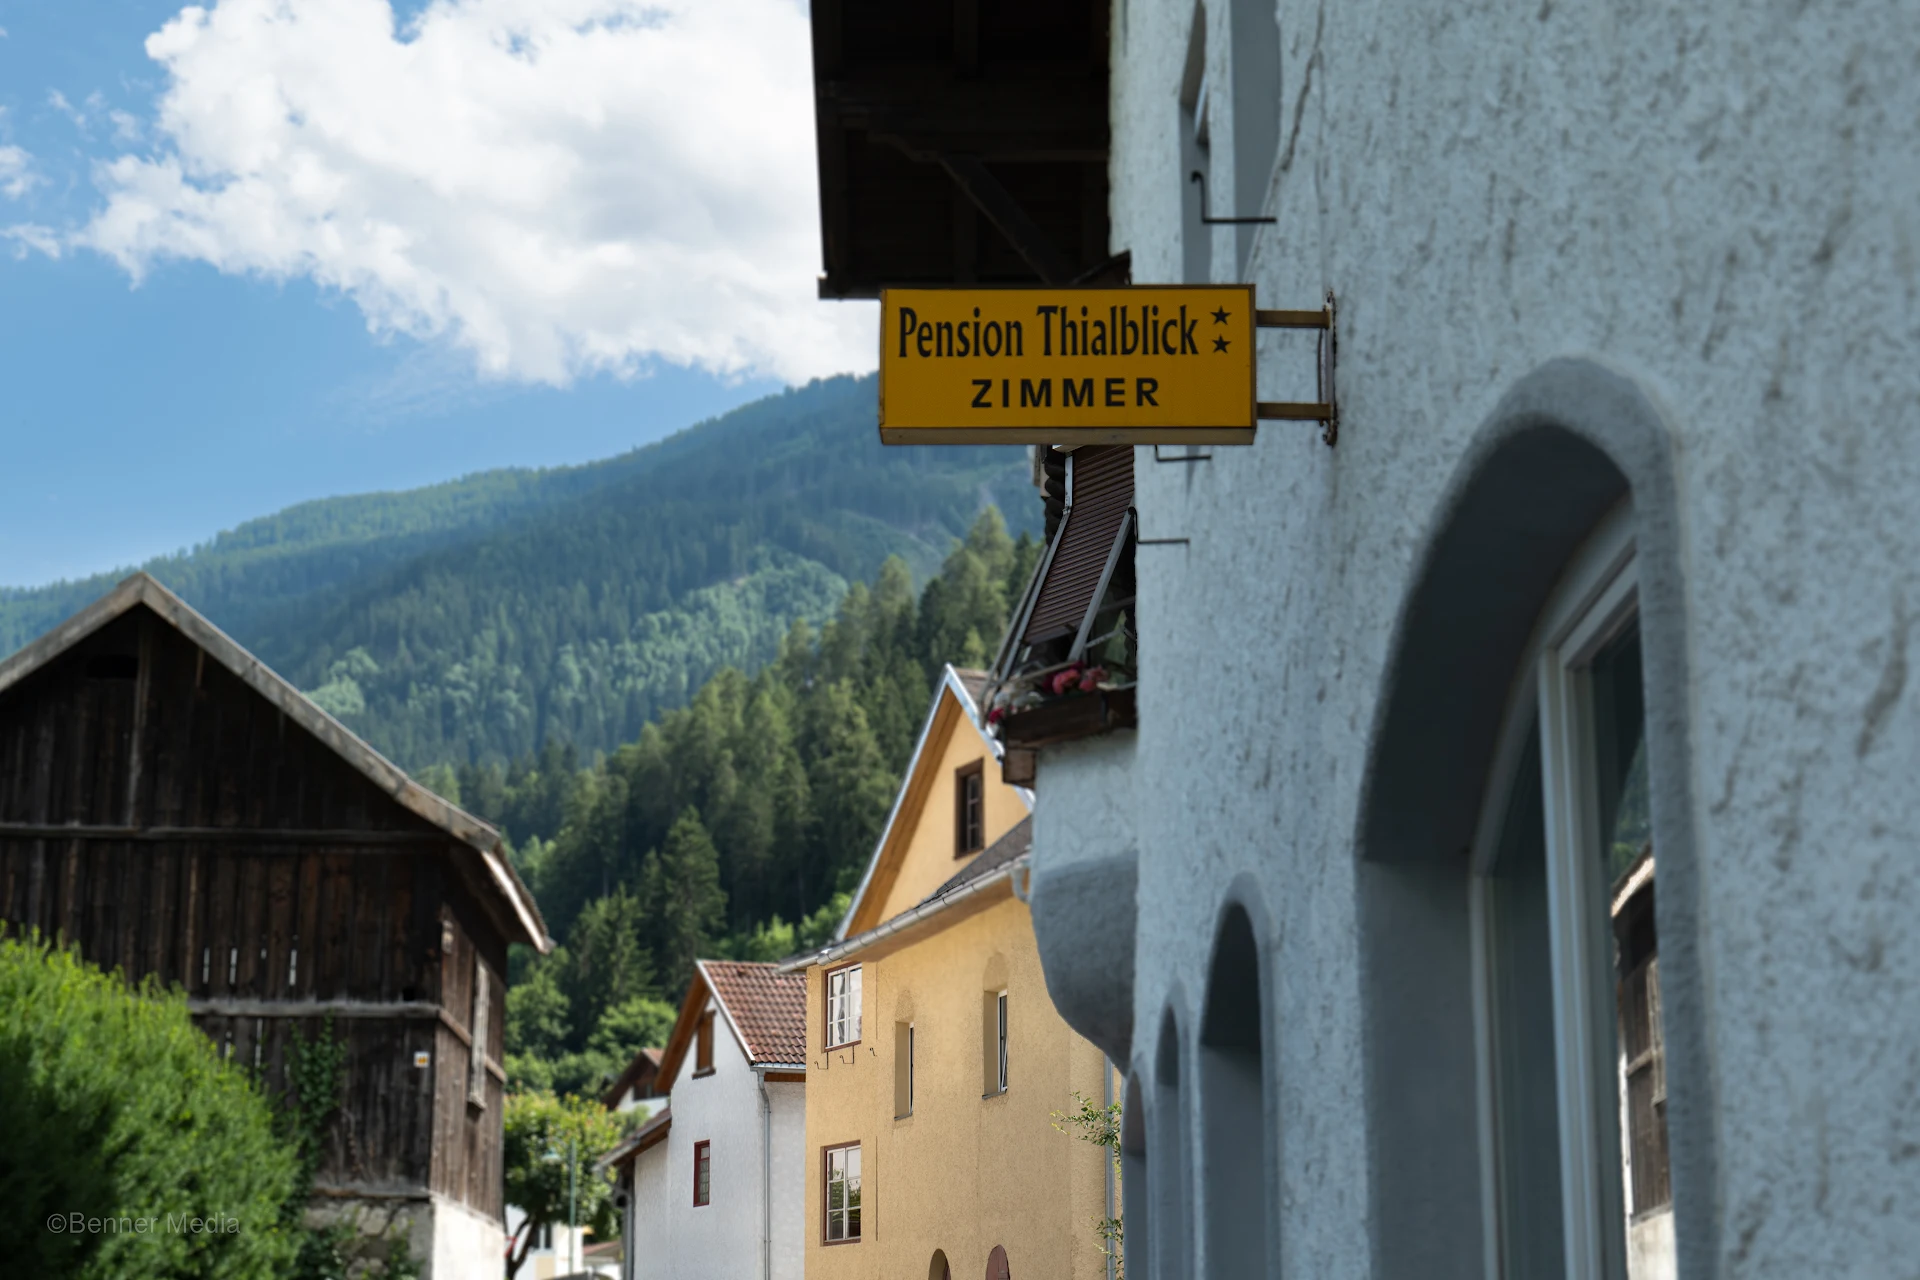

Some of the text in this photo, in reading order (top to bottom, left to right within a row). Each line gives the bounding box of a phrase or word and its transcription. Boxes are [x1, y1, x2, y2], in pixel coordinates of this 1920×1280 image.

[898, 304, 1199, 357] Pension Thialblick
[971, 377, 1160, 408] ZIMMER
